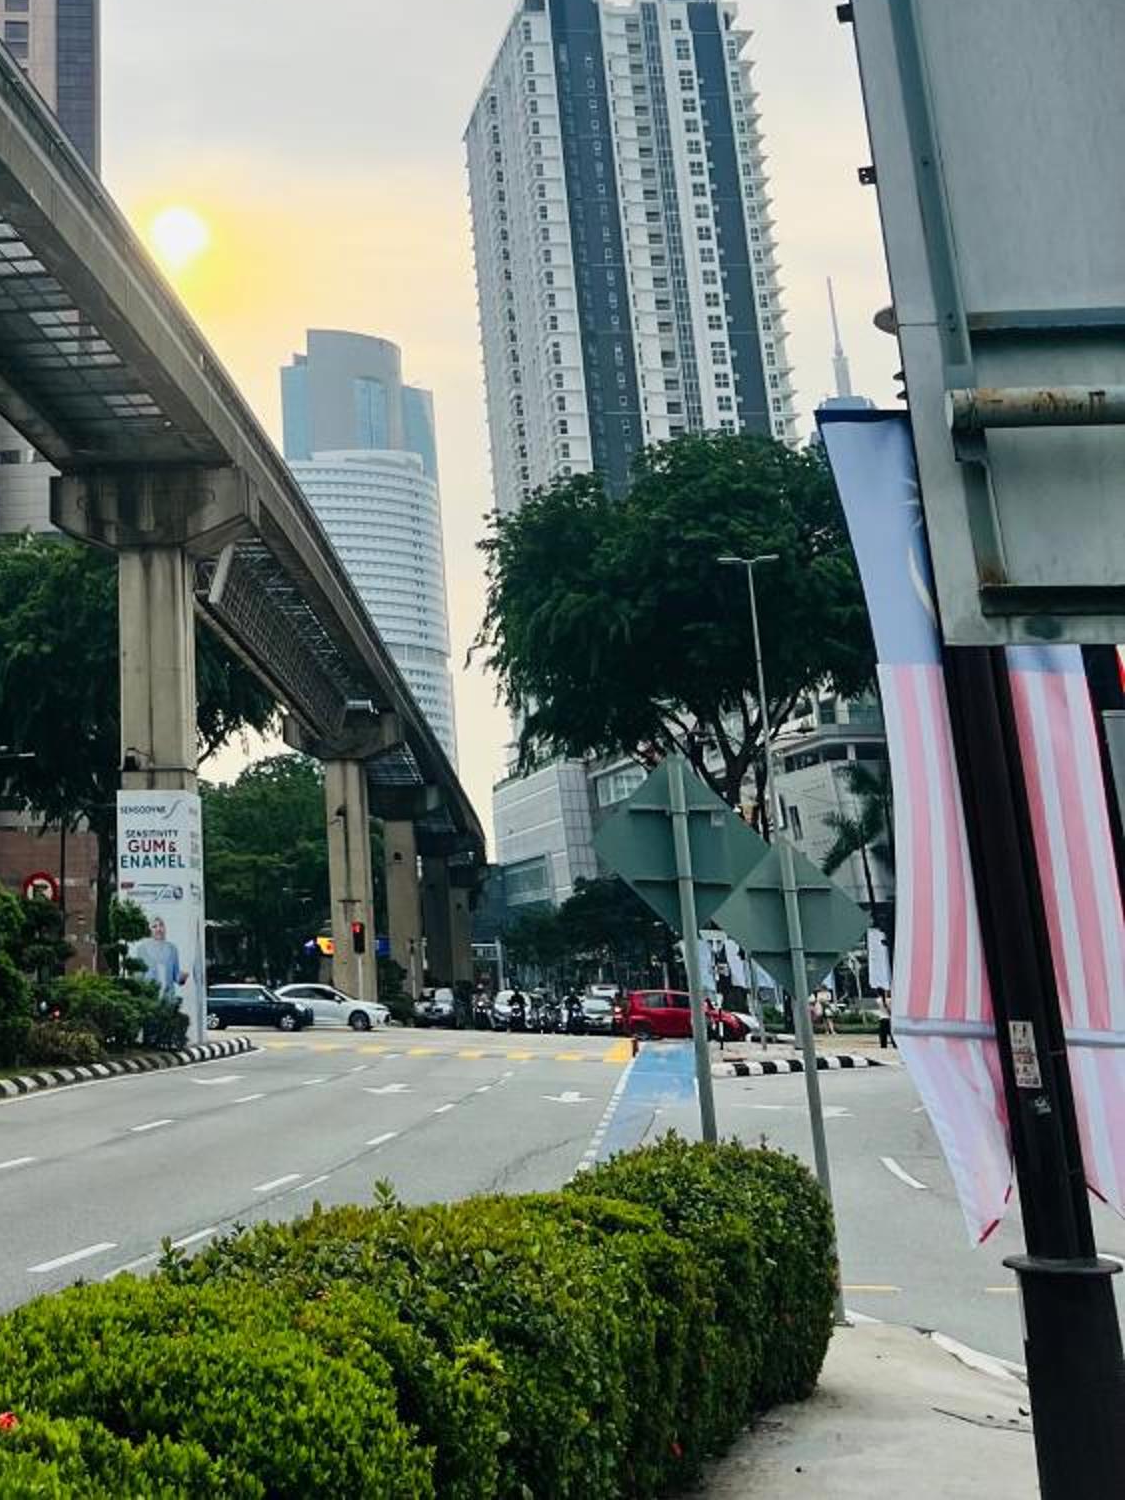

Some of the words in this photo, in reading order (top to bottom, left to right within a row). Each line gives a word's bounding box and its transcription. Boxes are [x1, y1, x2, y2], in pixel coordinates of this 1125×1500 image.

[120, 805, 167, 814] SENSODYNE
[125, 829, 179, 838] SENSITIVITY
[120, 854, 186, 869] ENAMEL
